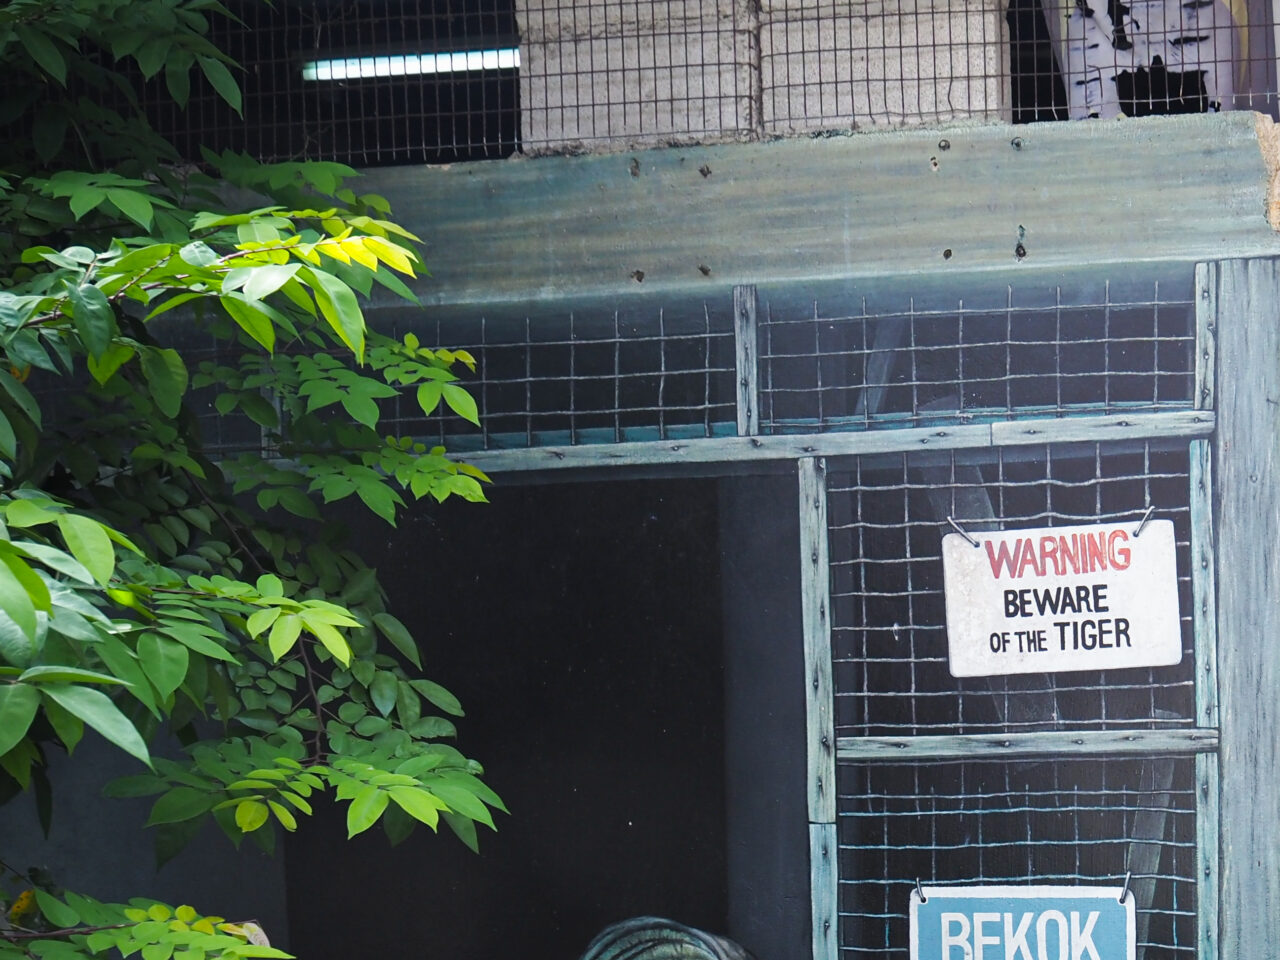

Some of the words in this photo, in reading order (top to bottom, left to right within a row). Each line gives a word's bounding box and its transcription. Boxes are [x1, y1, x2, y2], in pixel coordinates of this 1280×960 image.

[985, 530, 1131, 579] WARNING
[1004, 584, 1109, 617] BEWARE
[990, 632, 1010, 653] OF
[1015, 630, 1048, 652] THE
[1054, 618, 1132, 650] TIGER
